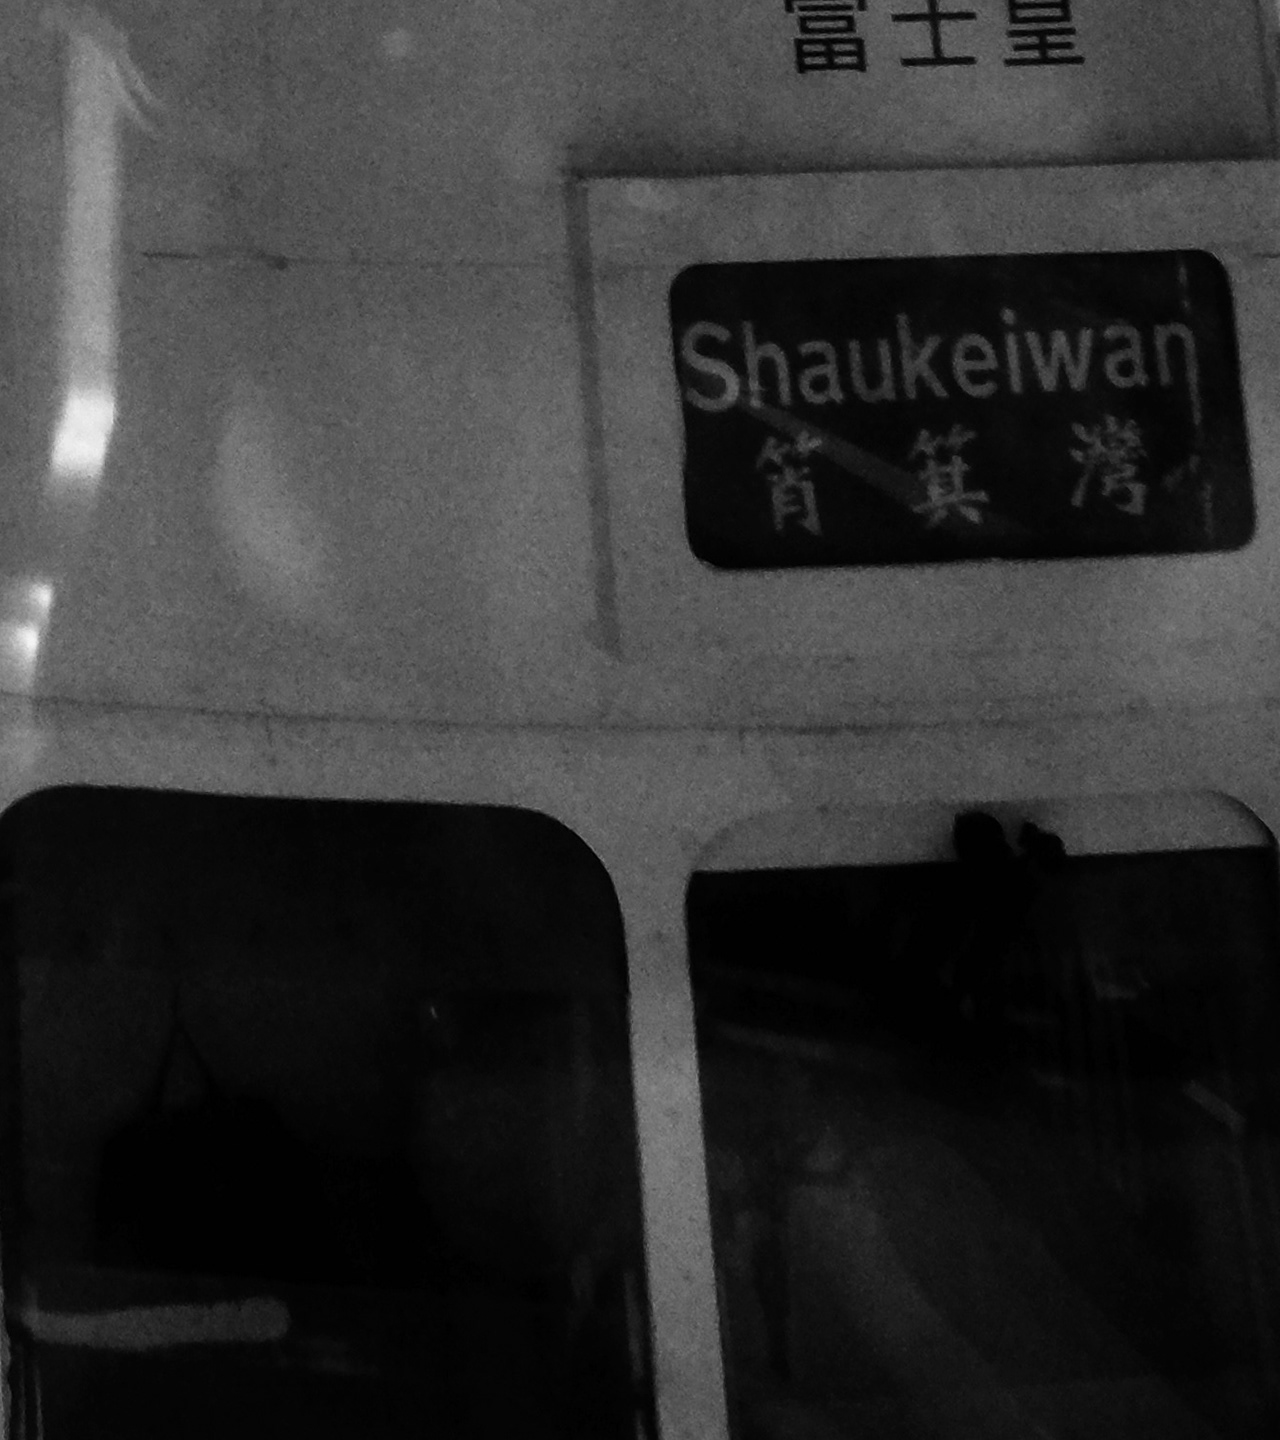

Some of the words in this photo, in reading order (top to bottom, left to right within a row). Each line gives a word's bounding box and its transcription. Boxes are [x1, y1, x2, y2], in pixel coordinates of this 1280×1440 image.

[681, 308, 1199, 414] Shaukeiwan
[757, 416, 1148, 537] 筲箕灣
